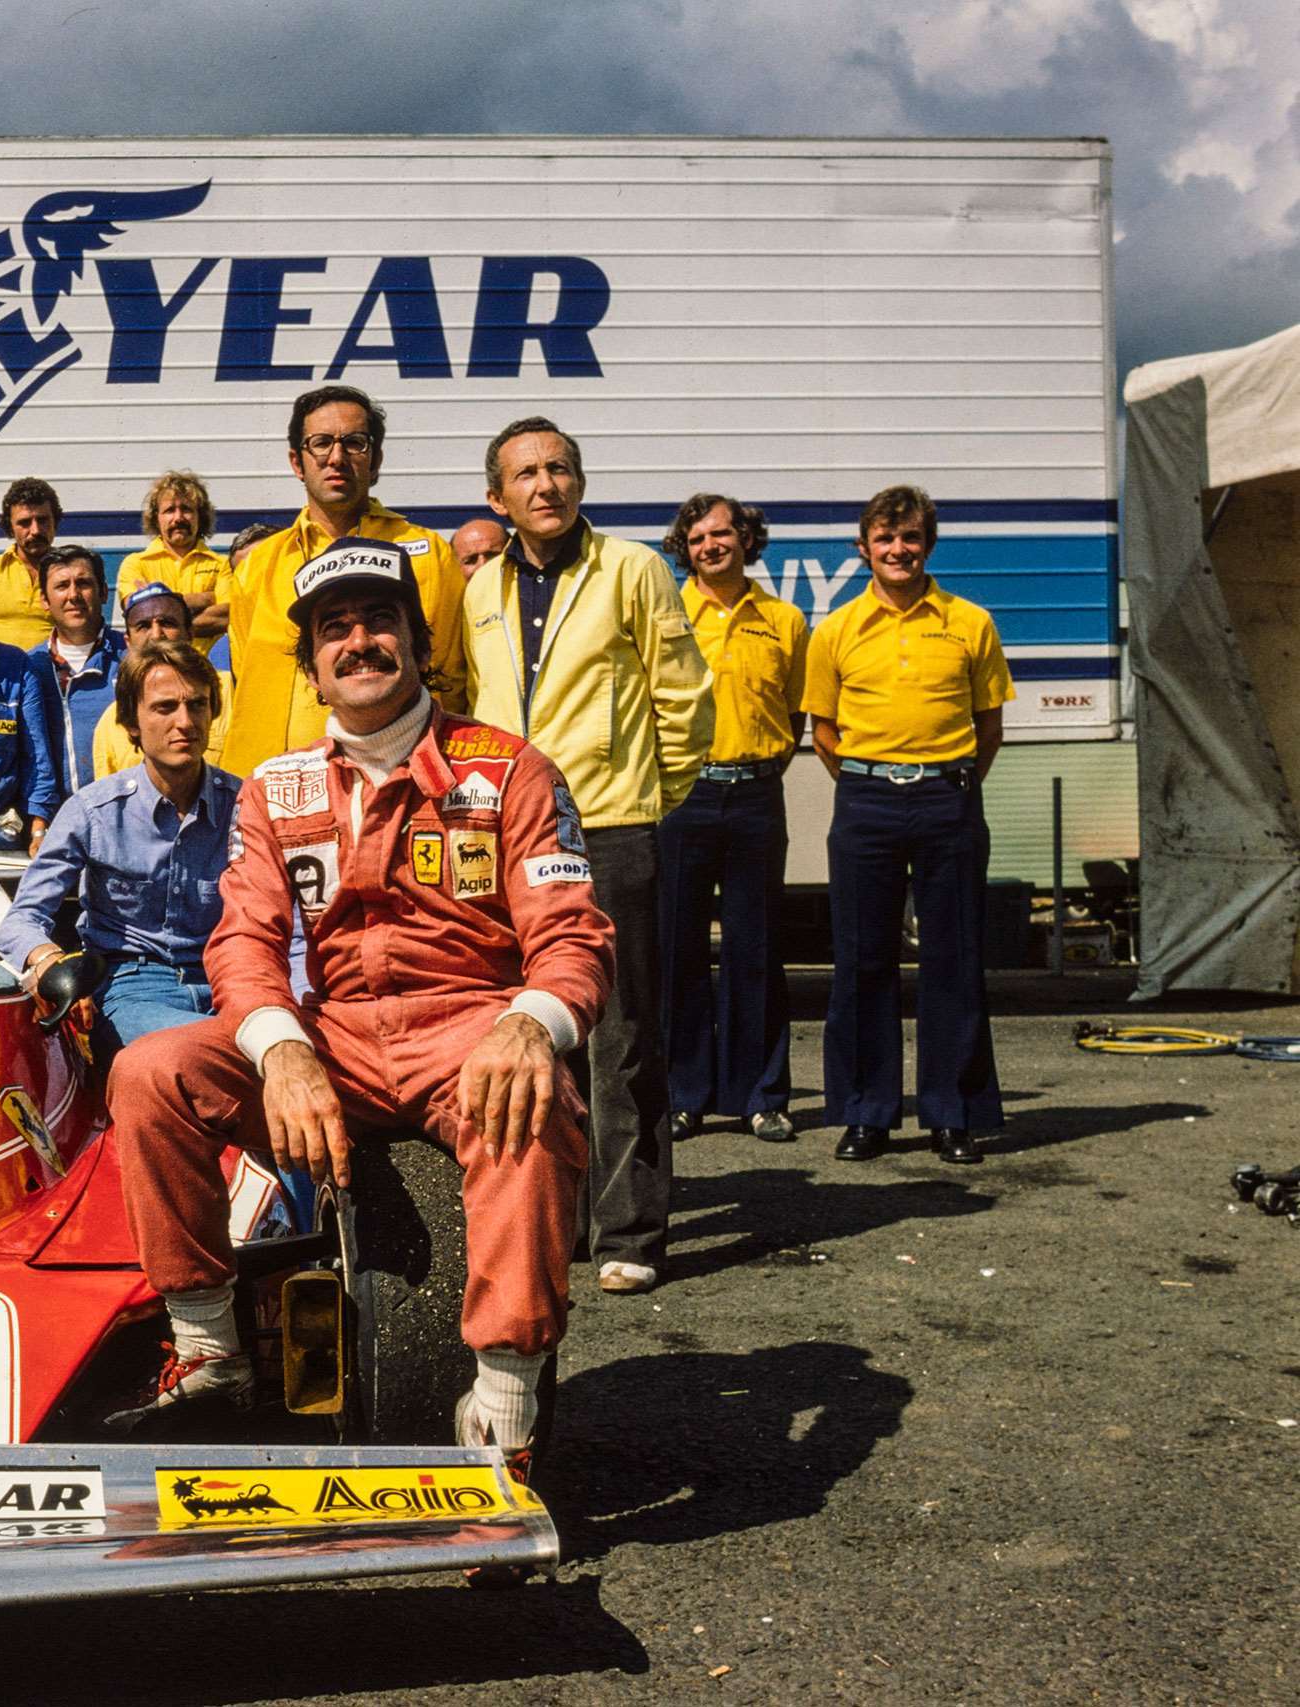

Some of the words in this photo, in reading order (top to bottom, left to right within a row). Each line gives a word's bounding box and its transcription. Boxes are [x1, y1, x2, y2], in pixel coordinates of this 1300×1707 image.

[94, 256, 611, 384] YEAR
[302, 559, 338, 590] GOOD
[349, 555, 392, 569] YEAR
[1041, 695, 1093, 707] YORK
[537, 863, 581, 878] GOOD
[457, 875, 493, 894] Agip
[312, 1474, 496, 1514] Agip
